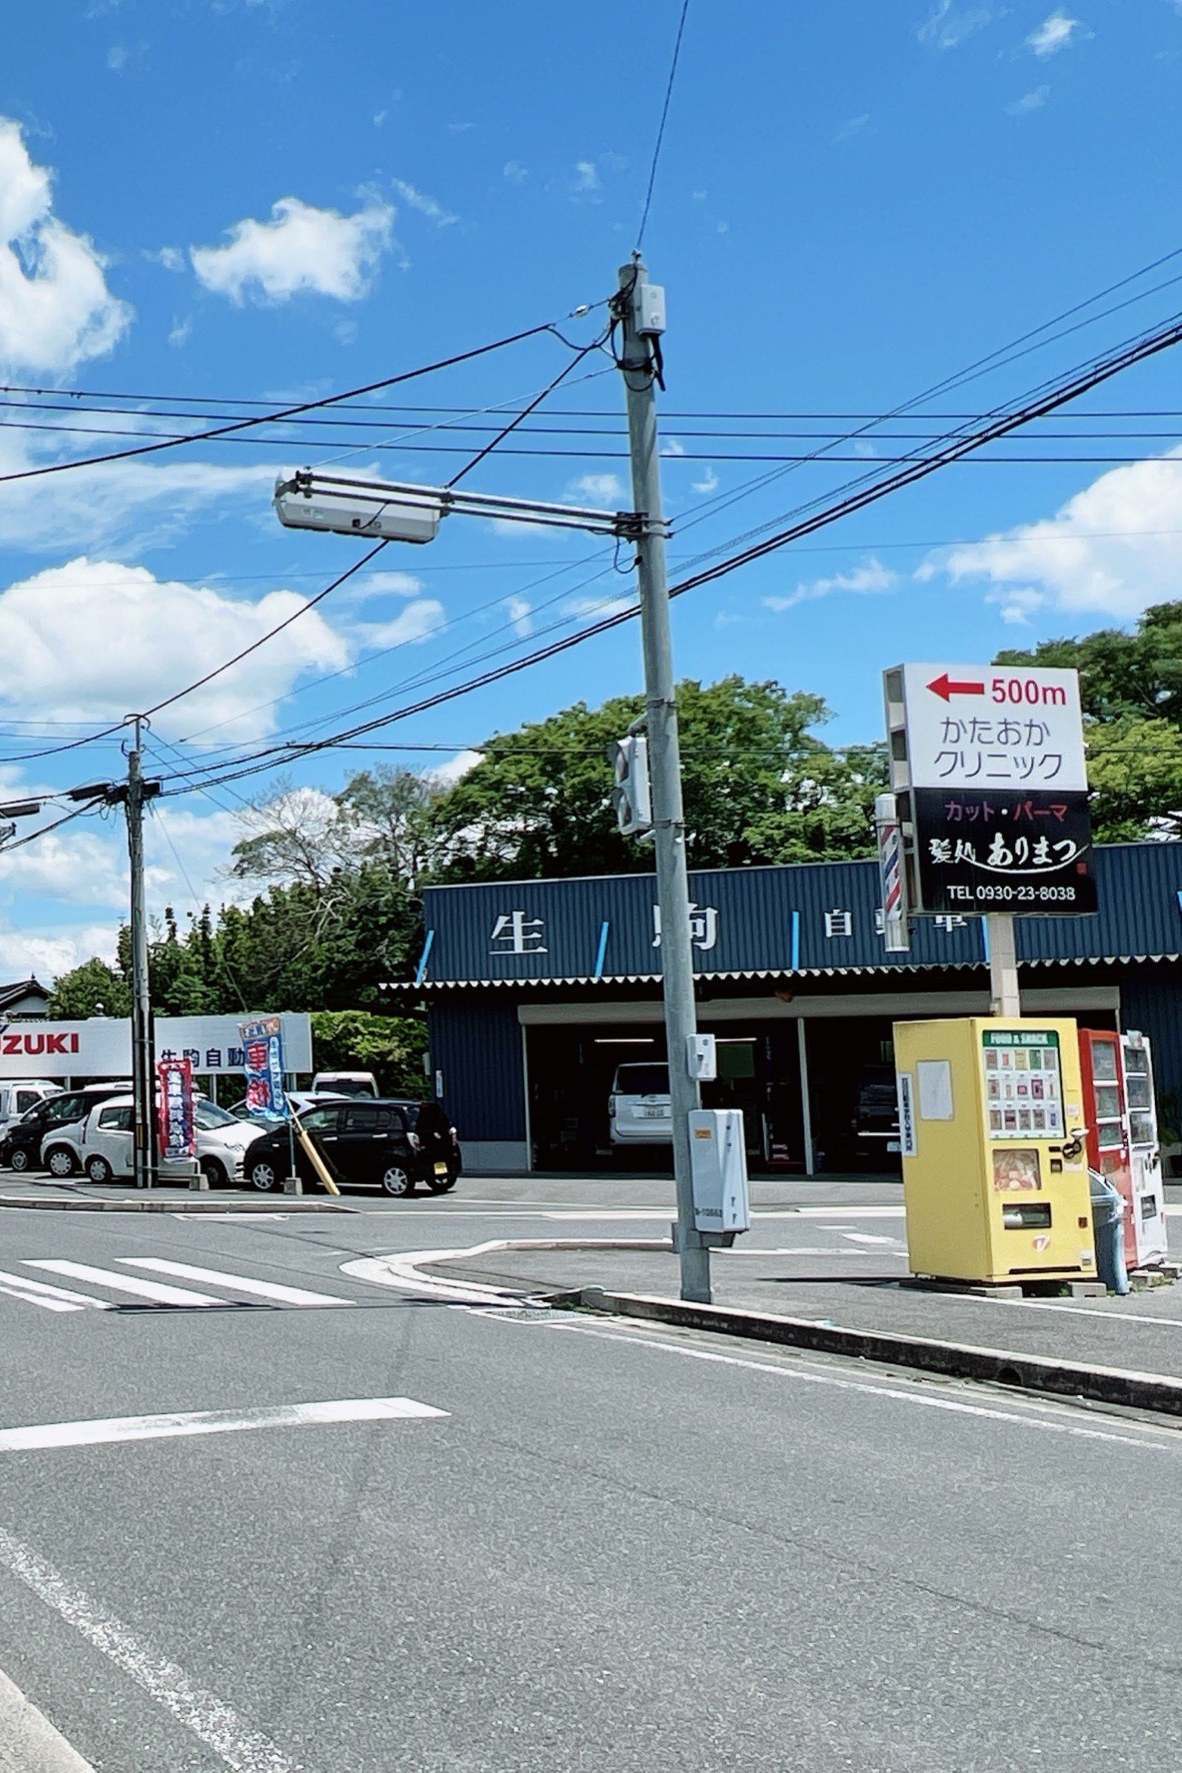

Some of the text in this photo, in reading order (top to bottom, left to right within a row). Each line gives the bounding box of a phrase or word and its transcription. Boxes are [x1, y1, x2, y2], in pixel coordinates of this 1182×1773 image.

[991, 679, 1067, 705] 500m
[940, 716, 1050, 746] かたおか
[933, 751, 1062, 780] クリニック
[945, 801, 1068, 822] カット・パーマ
[986, 832, 1077, 867] ありまつ
[947, 885, 1076, 901] TEL 0930-23-8038
